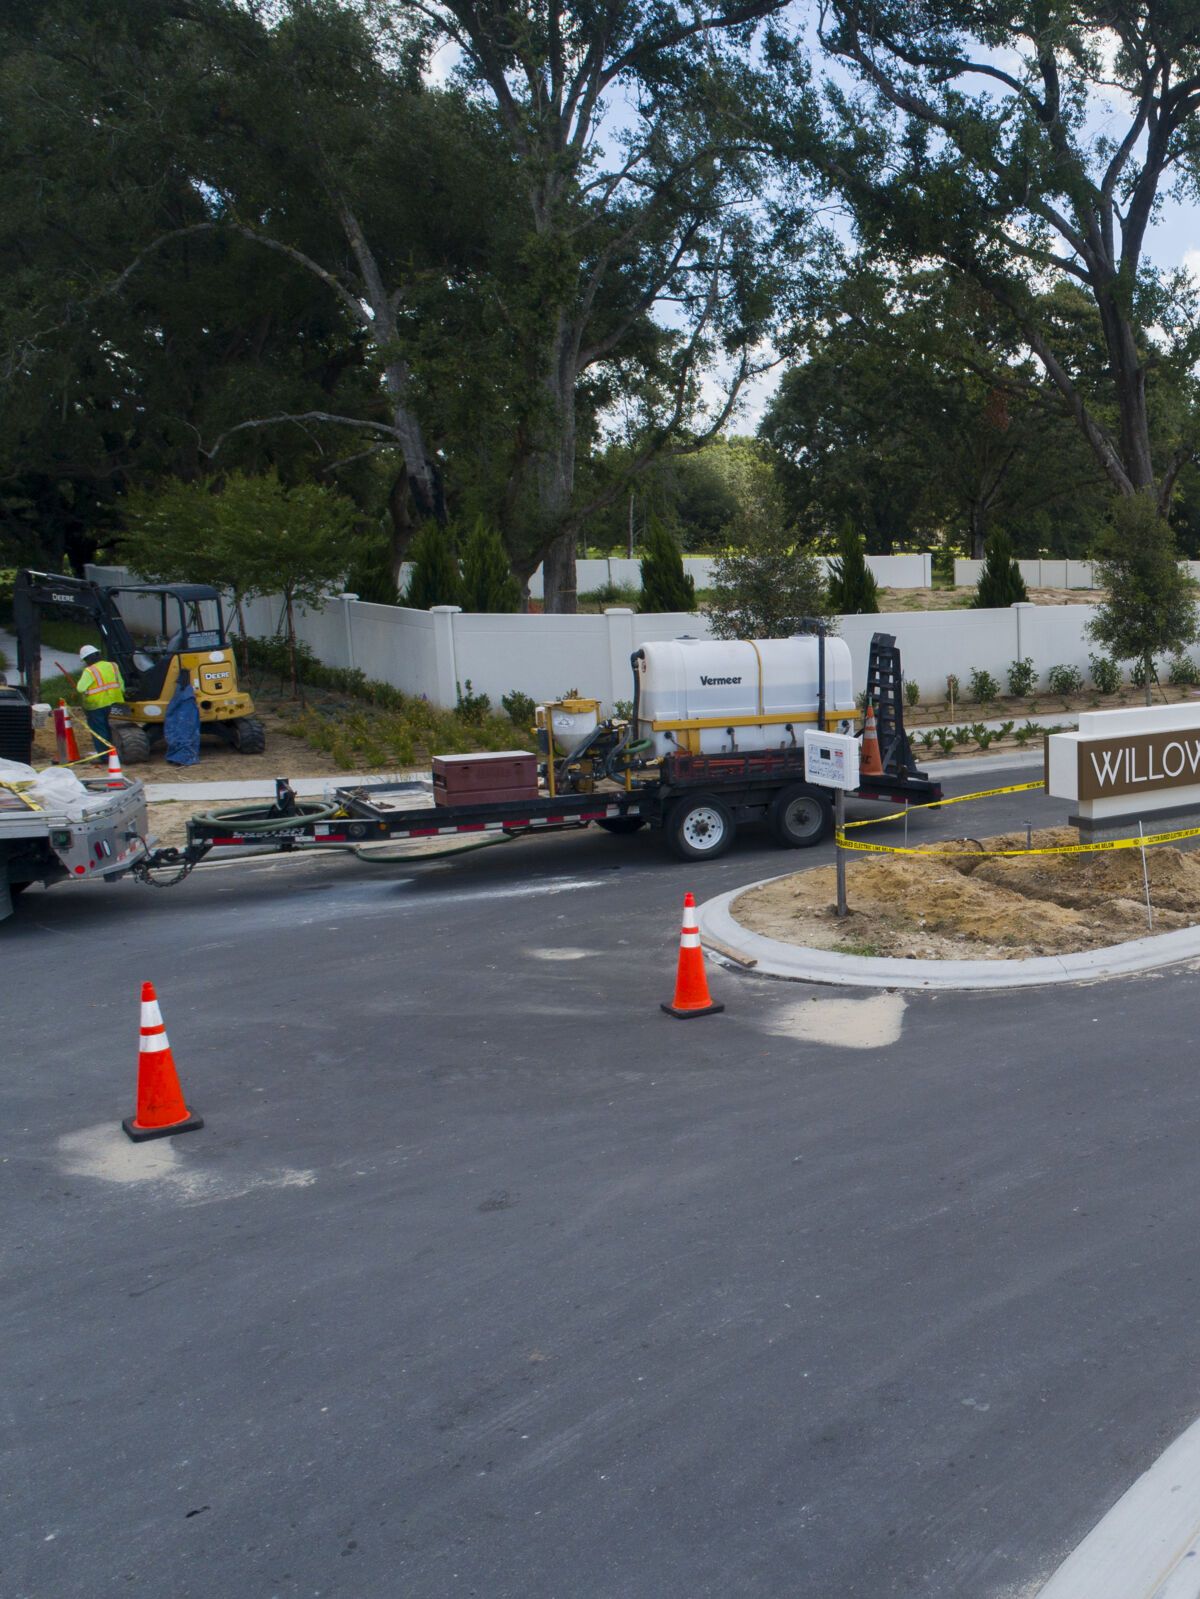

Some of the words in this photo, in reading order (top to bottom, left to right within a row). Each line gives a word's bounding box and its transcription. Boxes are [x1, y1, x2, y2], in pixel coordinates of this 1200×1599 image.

[52, 593, 75, 602] DEERE
[205, 672, 230, 680] DEERE
[700, 676, 742, 686] Vermeer
